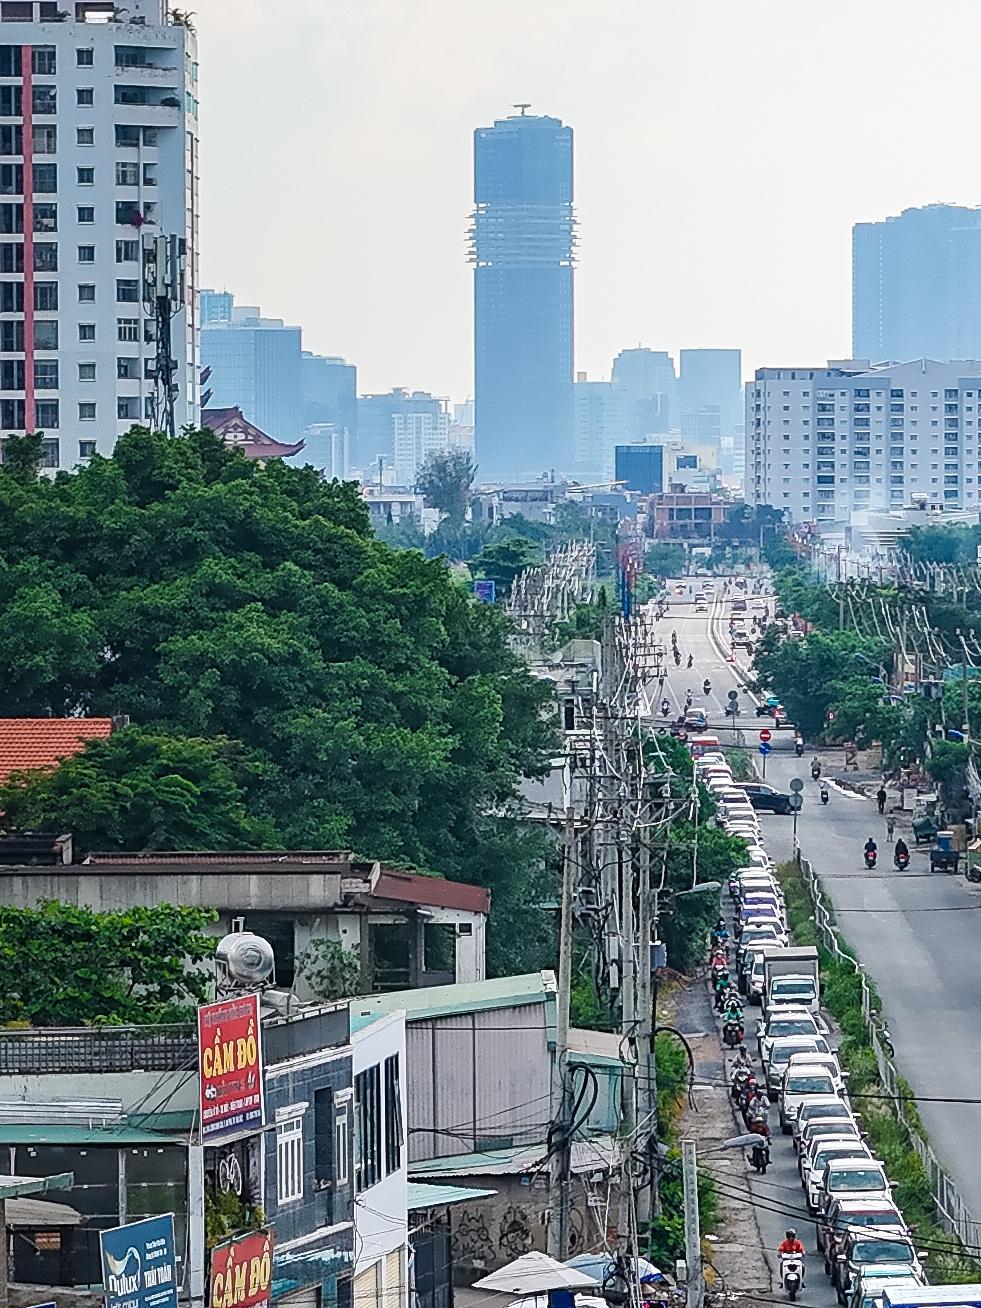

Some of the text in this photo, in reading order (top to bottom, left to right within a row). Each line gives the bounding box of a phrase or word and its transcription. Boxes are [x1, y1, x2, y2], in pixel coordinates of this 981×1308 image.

[203, 1018, 257, 1078] CẦM ĐỒ
[108, 1273, 139, 1297] Dulux
[248, 1230, 271, 1297] ĐỒ
